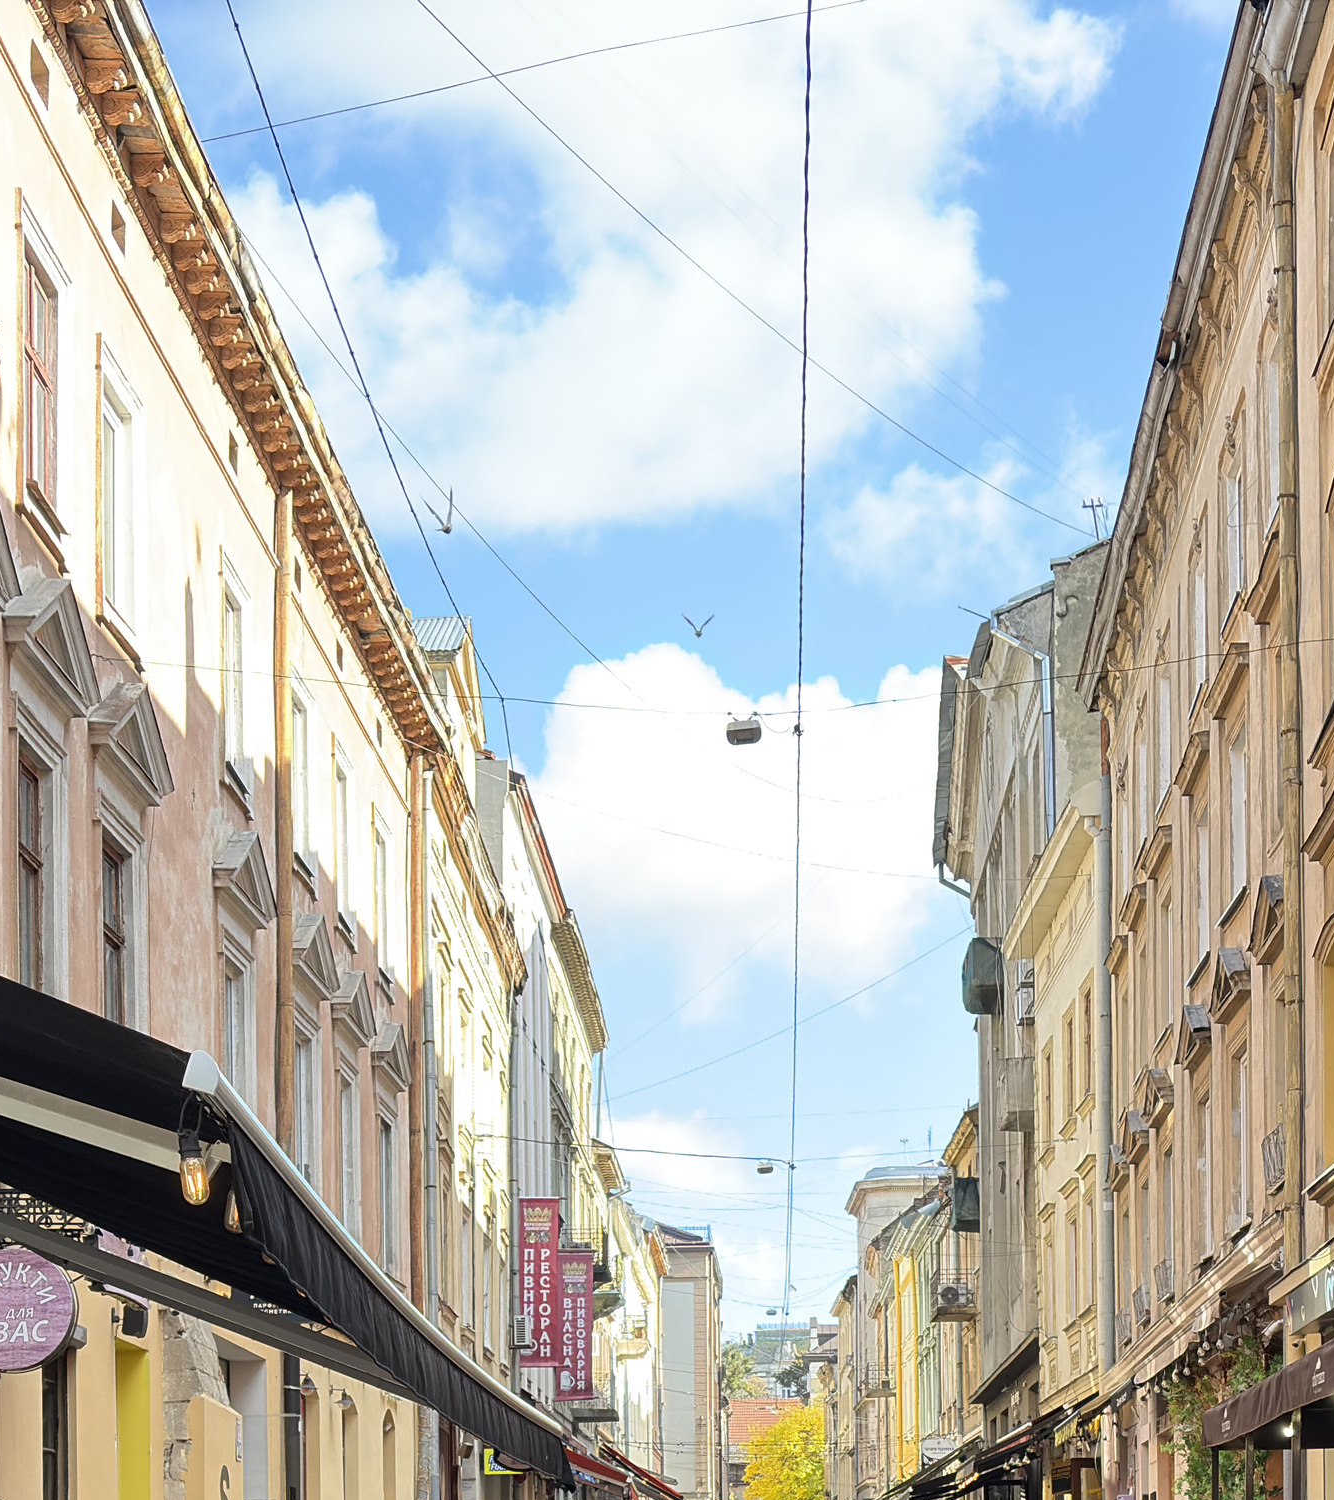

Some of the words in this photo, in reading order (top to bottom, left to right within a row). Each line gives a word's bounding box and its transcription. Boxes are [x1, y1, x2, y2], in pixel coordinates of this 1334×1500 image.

[538, 1248, 552, 1358] РЕСТОРАН
[562, 1297, 573, 1368] ВЛАСНА
[576, 1297, 586, 1391] ПИВОВАРНЯ
